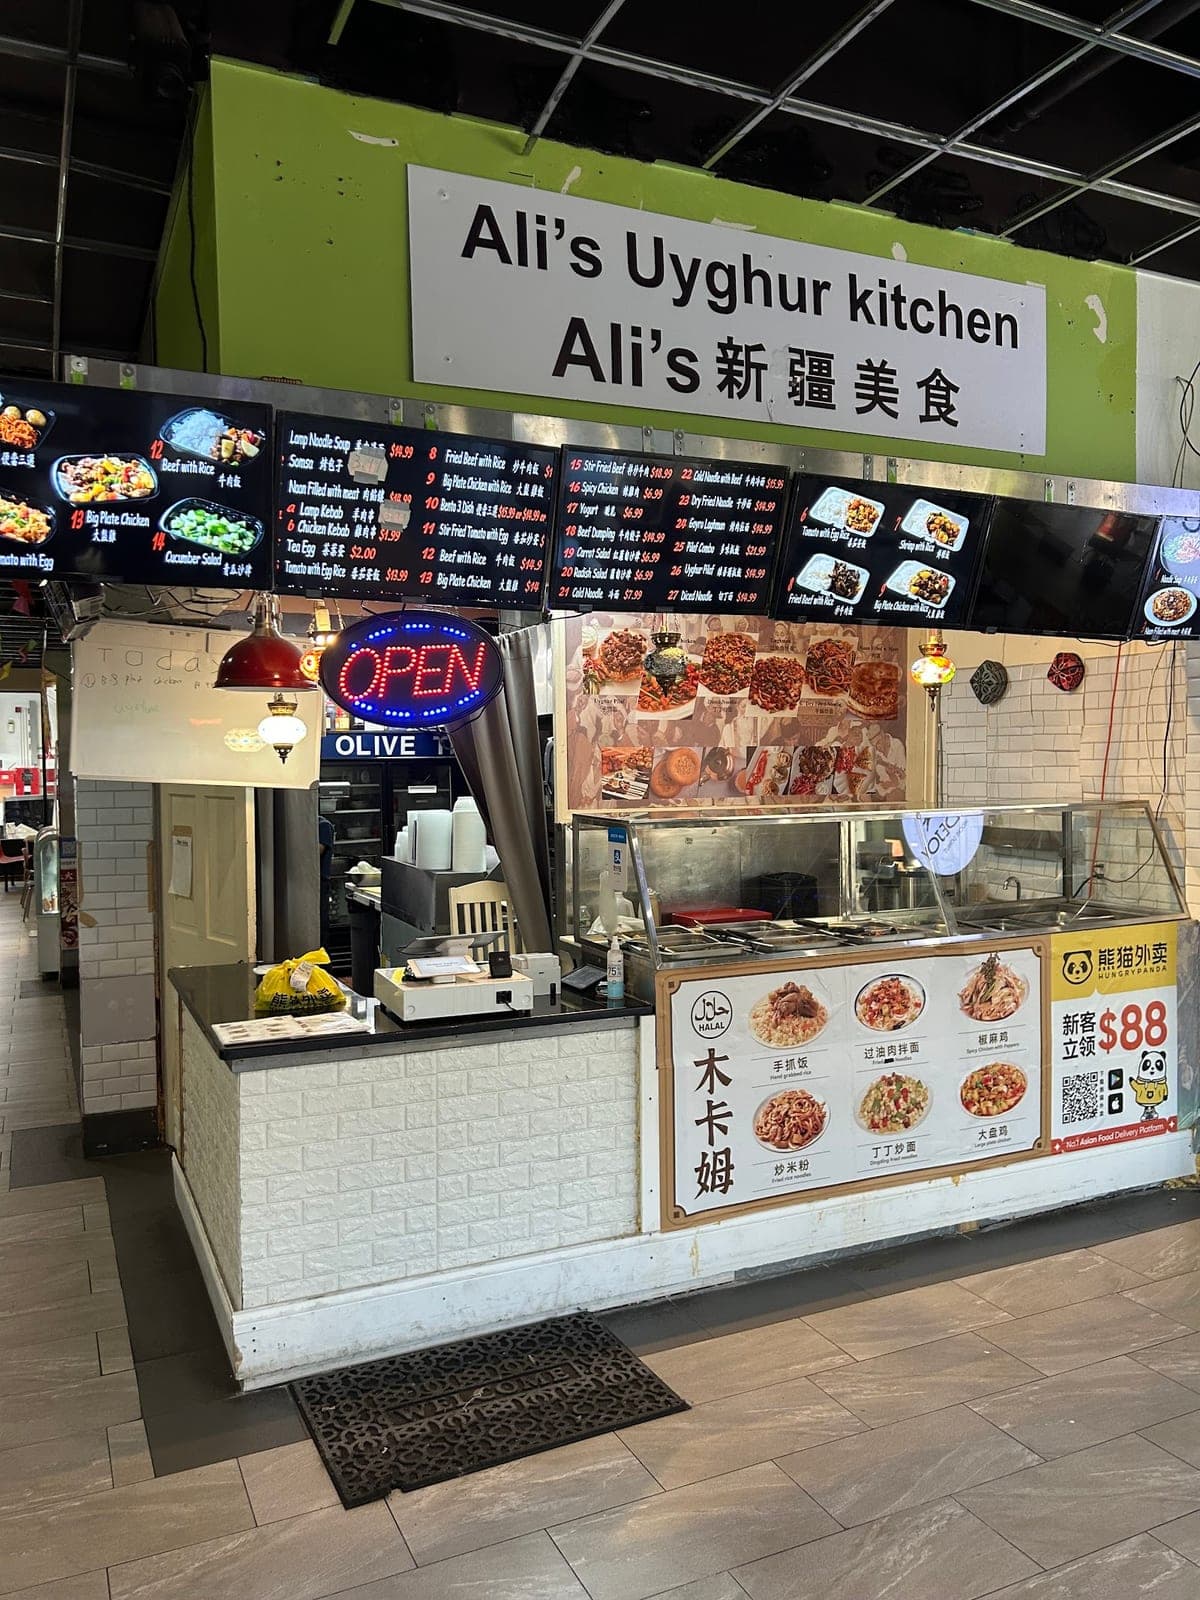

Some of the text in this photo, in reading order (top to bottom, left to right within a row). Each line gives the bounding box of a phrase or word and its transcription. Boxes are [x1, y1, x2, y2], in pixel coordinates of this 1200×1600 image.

[626, 231, 831, 315] Uyghur
[848, 273, 1019, 349] kitchen
[715, 336, 961, 428] 新疆美食
[309, 432, 333, 448] Noodle
[334, 436, 351, 454] Soup
[150, 440, 215, 475] 12 Beef with Rice
[288, 454, 314, 469] Samsa
[428, 446, 506, 470] 8 Fried Beef with Rice
[570, 459, 583, 470] 15
[583, 460, 596, 471] Stir
[596, 460, 612, 473] Fried
[612, 462, 626, 475] Beef
[681, 468, 693, 479] 22
[307, 481, 342, 498] Filled with
[425, 472, 512, 494] 9 Big Plate Chicken with Rice
[569, 481, 581, 493] 16
[581, 481, 597, 496] Spicy
[597, 482, 619, 495] Chicken
[643, 486, 663, 499] $6.99
[425, 496, 475, 514] 10 Bento 3 Dish
[566, 502, 644, 519] 17 Yogurt $6.99
[678, 494, 690, 505] 23
[691, 494, 701, 509] Dry
[701, 494, 716, 507] Fried
[71, 510, 150, 529] 13 Big Plate Chicken
[320, 504, 344, 519] Kebab
[800, 507, 808, 522] 6
[297, 520, 401, 542] Chicken Kebab $1.99
[894, 516, 902, 531] 7
[152, 532, 166, 550] 14
[422, 522, 509, 544] 11 Stir Fried Tomato with Egg
[565, 525, 616, 542] 18 Beef Dumpling
[802, 525, 820, 538] Tomato
[830, 528, 840, 542] Egg
[839, 529, 850, 540] Rice
[286, 539, 377, 560] Tea Egg $2.00
[563, 547, 575, 558] 19
[576, 546, 595, 558] Carrot
[595, 548, 611, 560] Salad
[641, 551, 660, 563] $6.99
[673, 541, 686, 552] 25
[20, 553, 54, 571] with Egg
[165, 551, 223, 566] Cucumber Salad
[421, 547, 487, 566] 12 Beef with Rice
[284, 560, 409, 582] Tomato with Egg Rice $13.99
[561, 567, 574, 577] 20
[574, 566, 592, 579] Radish
[592, 567, 608, 580] Salad
[634, 569, 654, 581] $6.99
[670, 565, 682, 576] 26
[419, 571, 491, 589] 13 Big Plate Chicken
[558, 586, 643, 601] 21 Cold Noodle $7.99
[667, 590, 680, 600] 27
[680, 589, 696, 601] Diced
[788, 593, 801, 605] Fried
[893, 601, 909, 612] Chicken
[339, 641, 486, 700] OPEN
[335, 735, 416, 756] OLIVE
[1098, 942, 1167, 972] 熊猫外卖
[1098, 965, 1167, 979] HUNGRYPANDA
[699, 1021, 725, 1032] HALAL
[1062, 1011, 1096, 1036] 新客
[1098, 1001, 1168, 1054] $88
[978, 1031, 1008, 1046] 椒麻鸡
[863, 1041, 920, 1060] 过油肉拌面
[1062, 1036, 1096, 1060] 立领
[773, 1056, 809, 1073] 手抓饭
[693, 1048, 735, 1200] 木卡姆
[978, 1125, 1008, 1141] 大盘鸡
[1079, 1137, 1098, 1147] Asian
[1098, 1133, 1114, 1142] Food
[1114, 1128, 1139, 1139] Delivery
[1139, 1123, 1164, 1134] Platform
[872, 1140, 917, 1159] 丁丁炒面
[774, 1158, 810, 1177] 炒米粉
[771, 1176, 784, 1184] Fried
